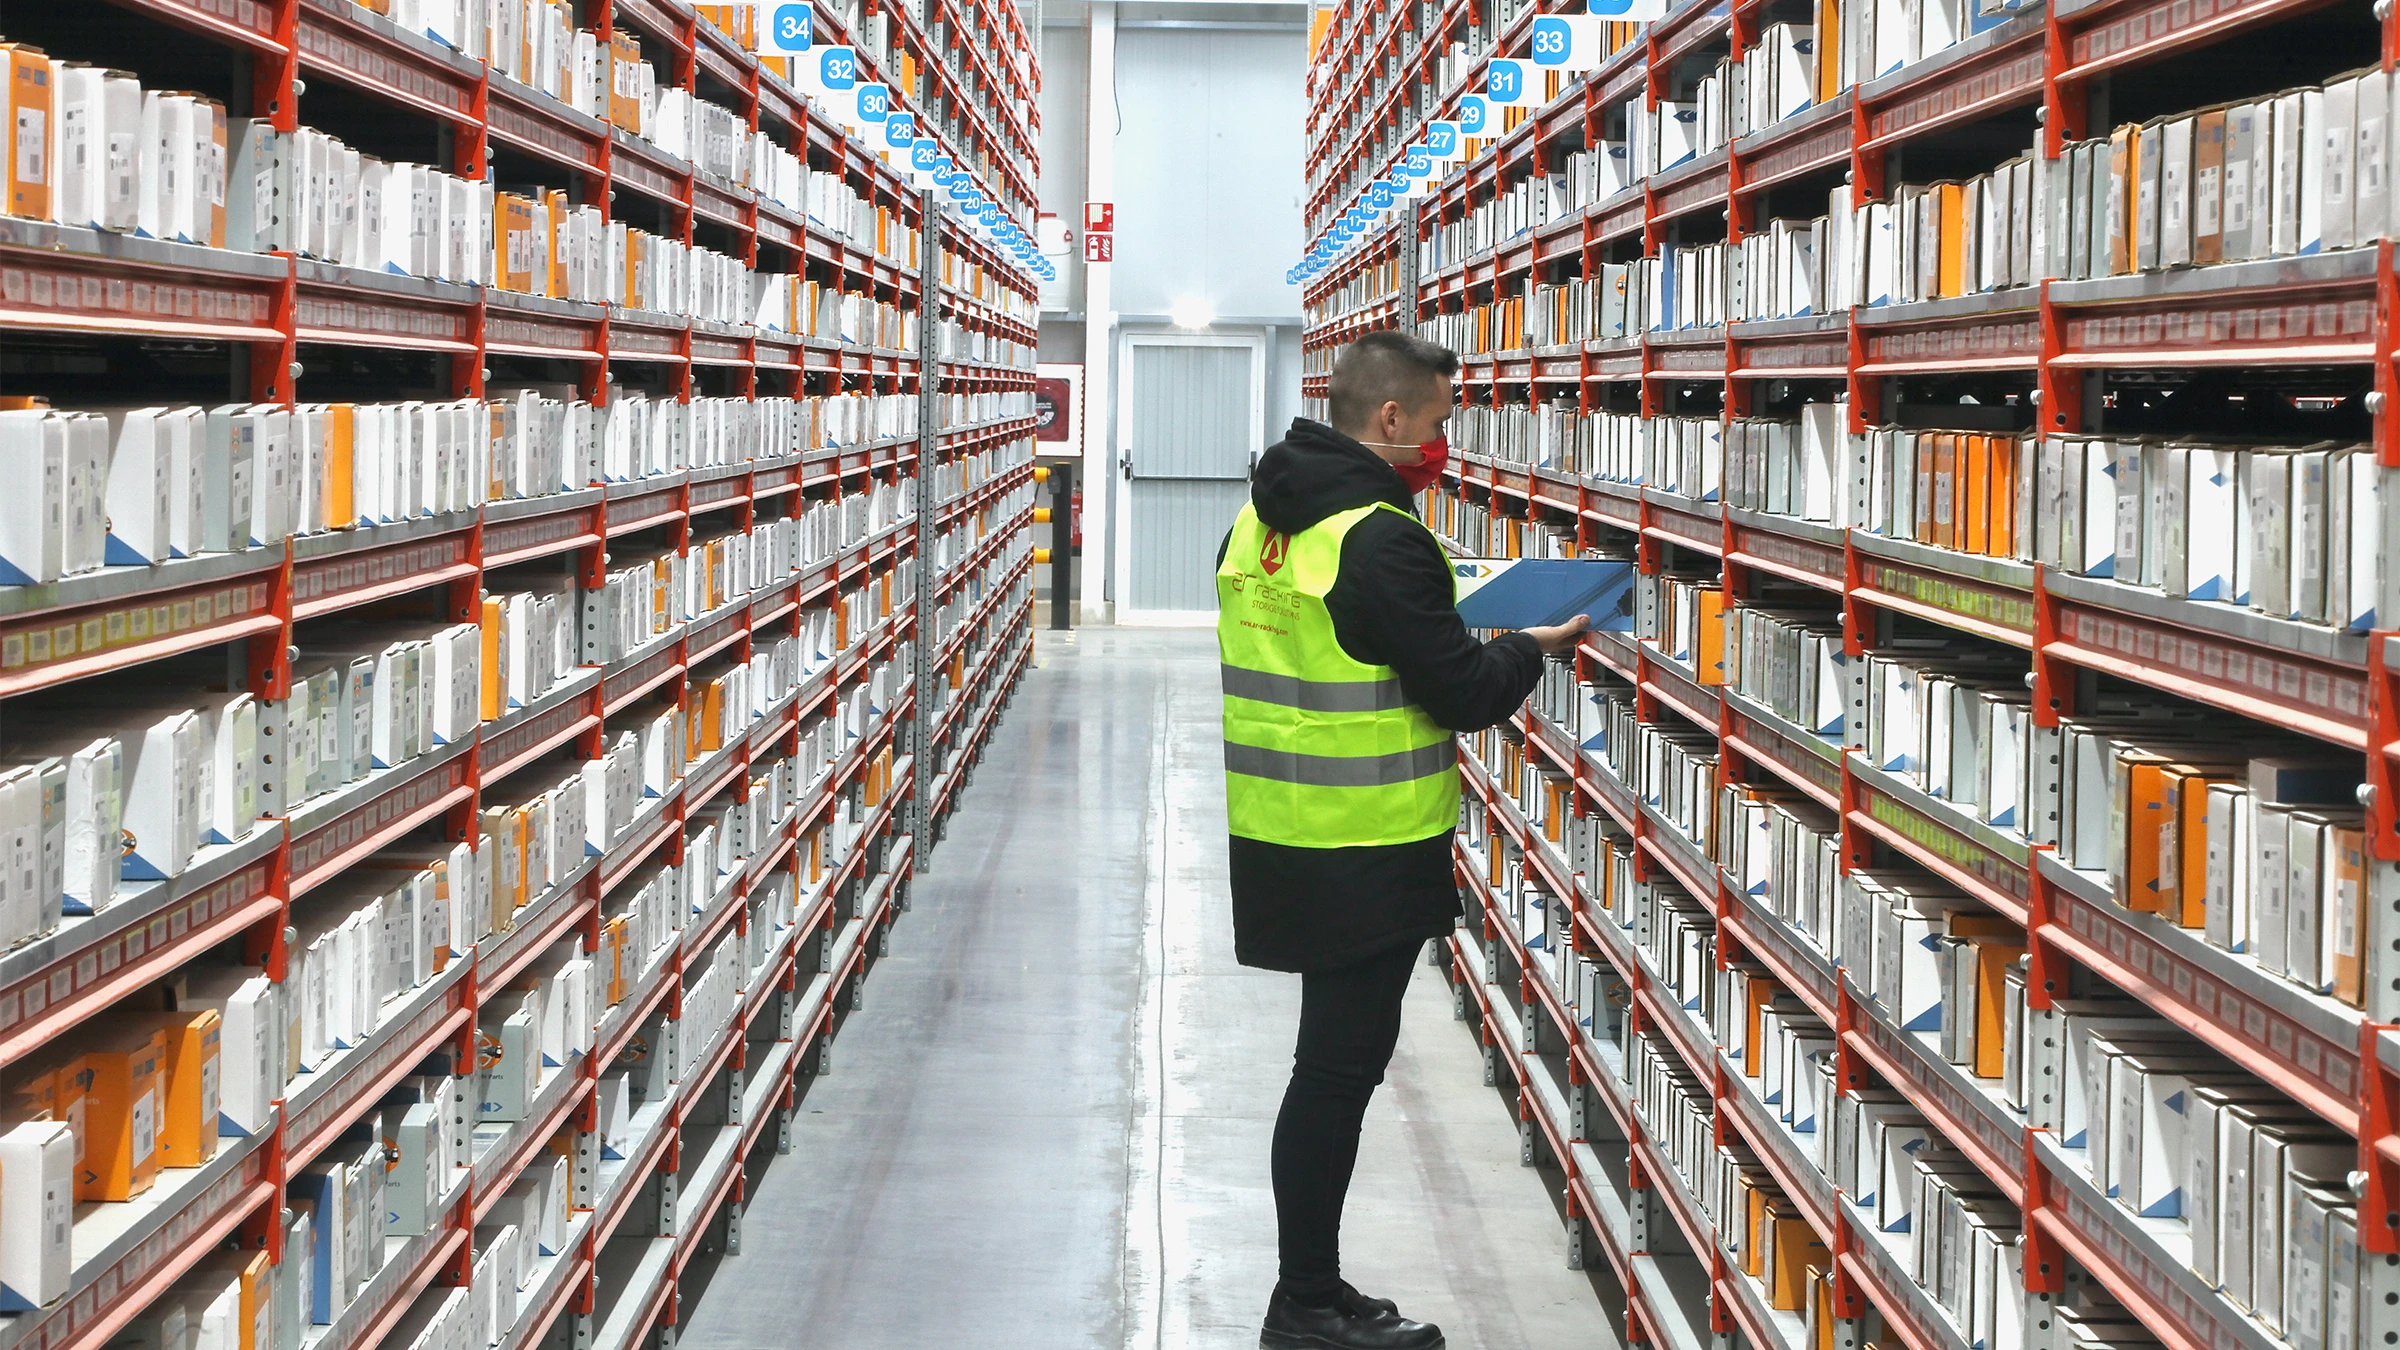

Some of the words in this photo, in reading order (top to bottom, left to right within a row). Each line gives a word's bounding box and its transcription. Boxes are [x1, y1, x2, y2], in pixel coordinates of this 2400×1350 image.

[781, 16, 809, 40] 34
[1535, 30, 1564, 53] 33
[828, 59, 853, 80] 32
[1490, 71, 1514, 92] 31
[863, 94, 886, 114] 30
[1460, 106, 1480, 124] 29
[891, 122, 912, 140] 28
[1430, 132, 1450, 149] 27
[916, 147, 936, 164] 26
[1408, 154, 1428, 170] 25
[937, 165, 952, 179] 24
[953, 180, 970, 194] 22
[1392, 173, 1406, 188] 23
[1374, 187, 1389, 202] 21
[965, 197, 980, 209] 20
[1361, 202, 1374, 214] 19
[983, 210, 996, 220] 18
[1349, 216, 1360, 226] 17
[996, 221, 1007, 231] 16
[1338, 226, 1348, 236] 15
[1232, 572, 1256, 592] ar
